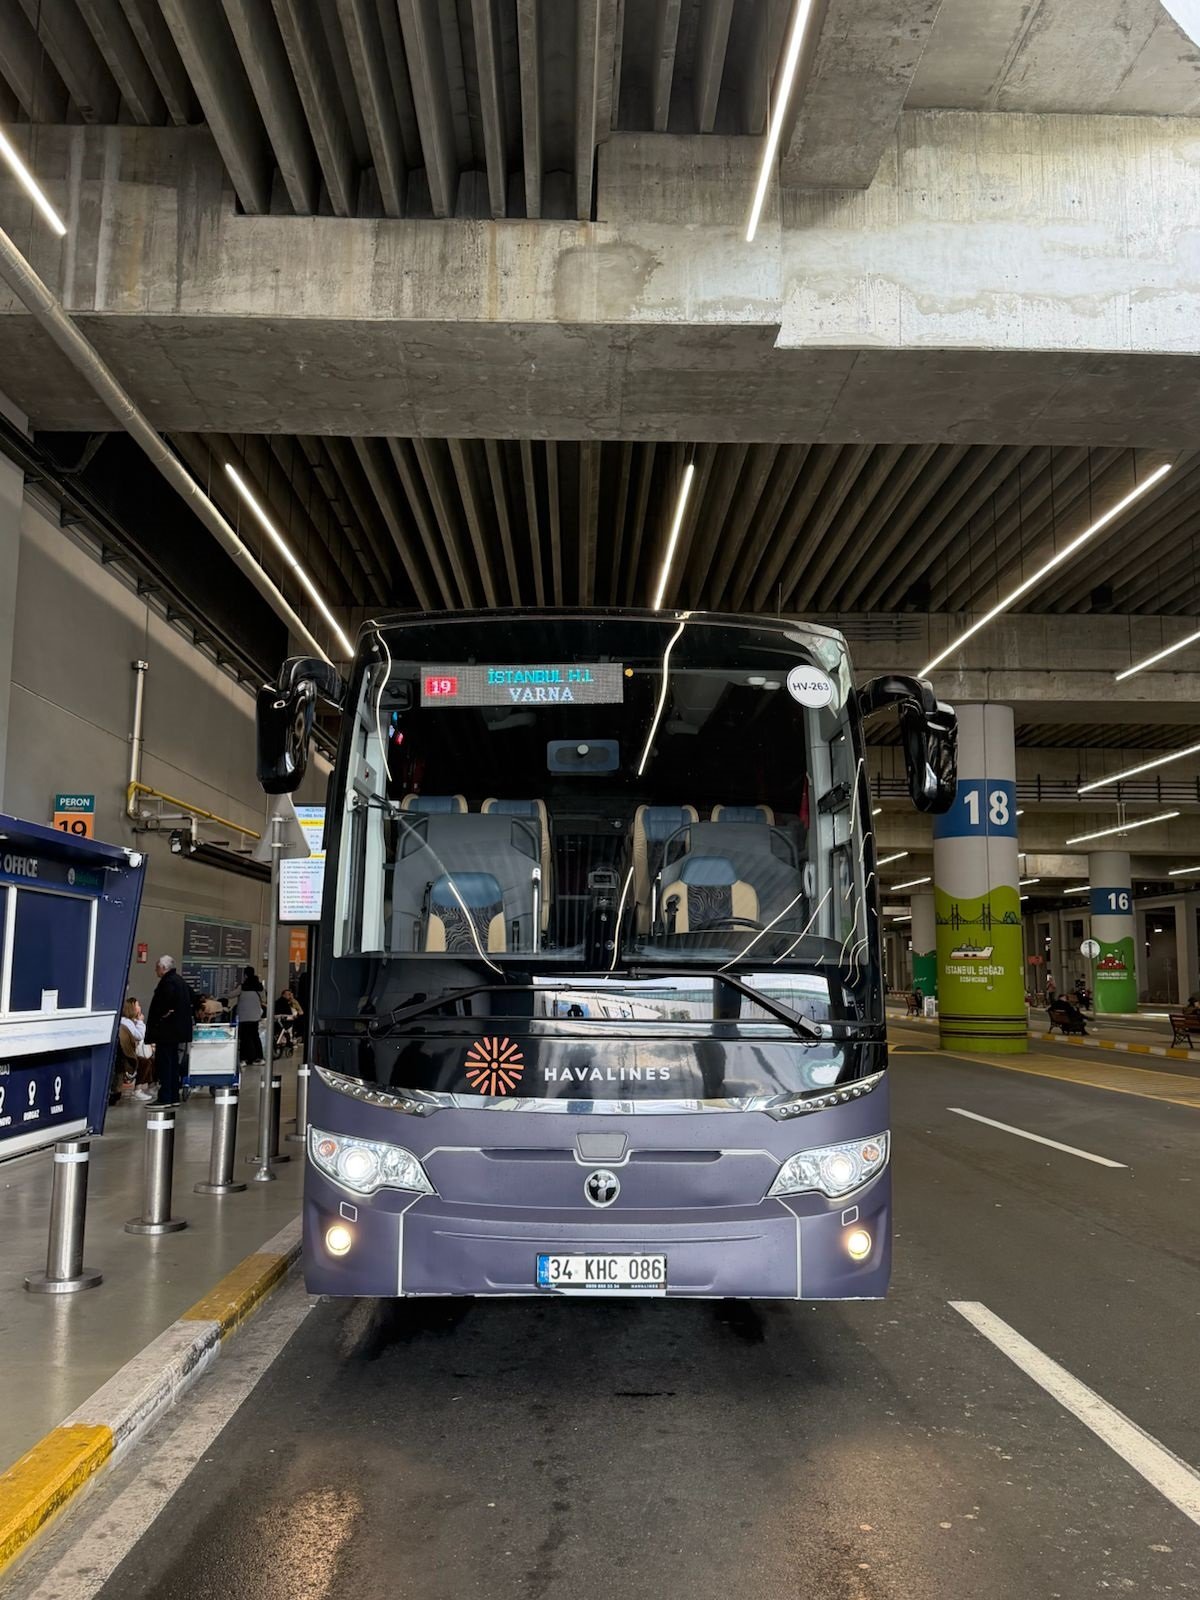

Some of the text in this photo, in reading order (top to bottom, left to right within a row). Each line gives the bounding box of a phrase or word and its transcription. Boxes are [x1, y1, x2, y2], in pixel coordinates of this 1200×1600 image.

[488, 668, 564, 684] İSTANBUL
[431, 680, 451, 694] 19
[509, 687, 575, 702] VARNA
[792, 682, 829, 691] HV-263
[59, 797, 91, 807] PERON
[963, 790, 1010, 826] 18
[58, 820, 88, 837] 19
[3, 854, 38, 878] OFFICE
[1108, 892, 1130, 911] 16
[544, 1066, 671, 1081] HAVALINES
[550, 1258, 662, 1280] 34 KHC 086
